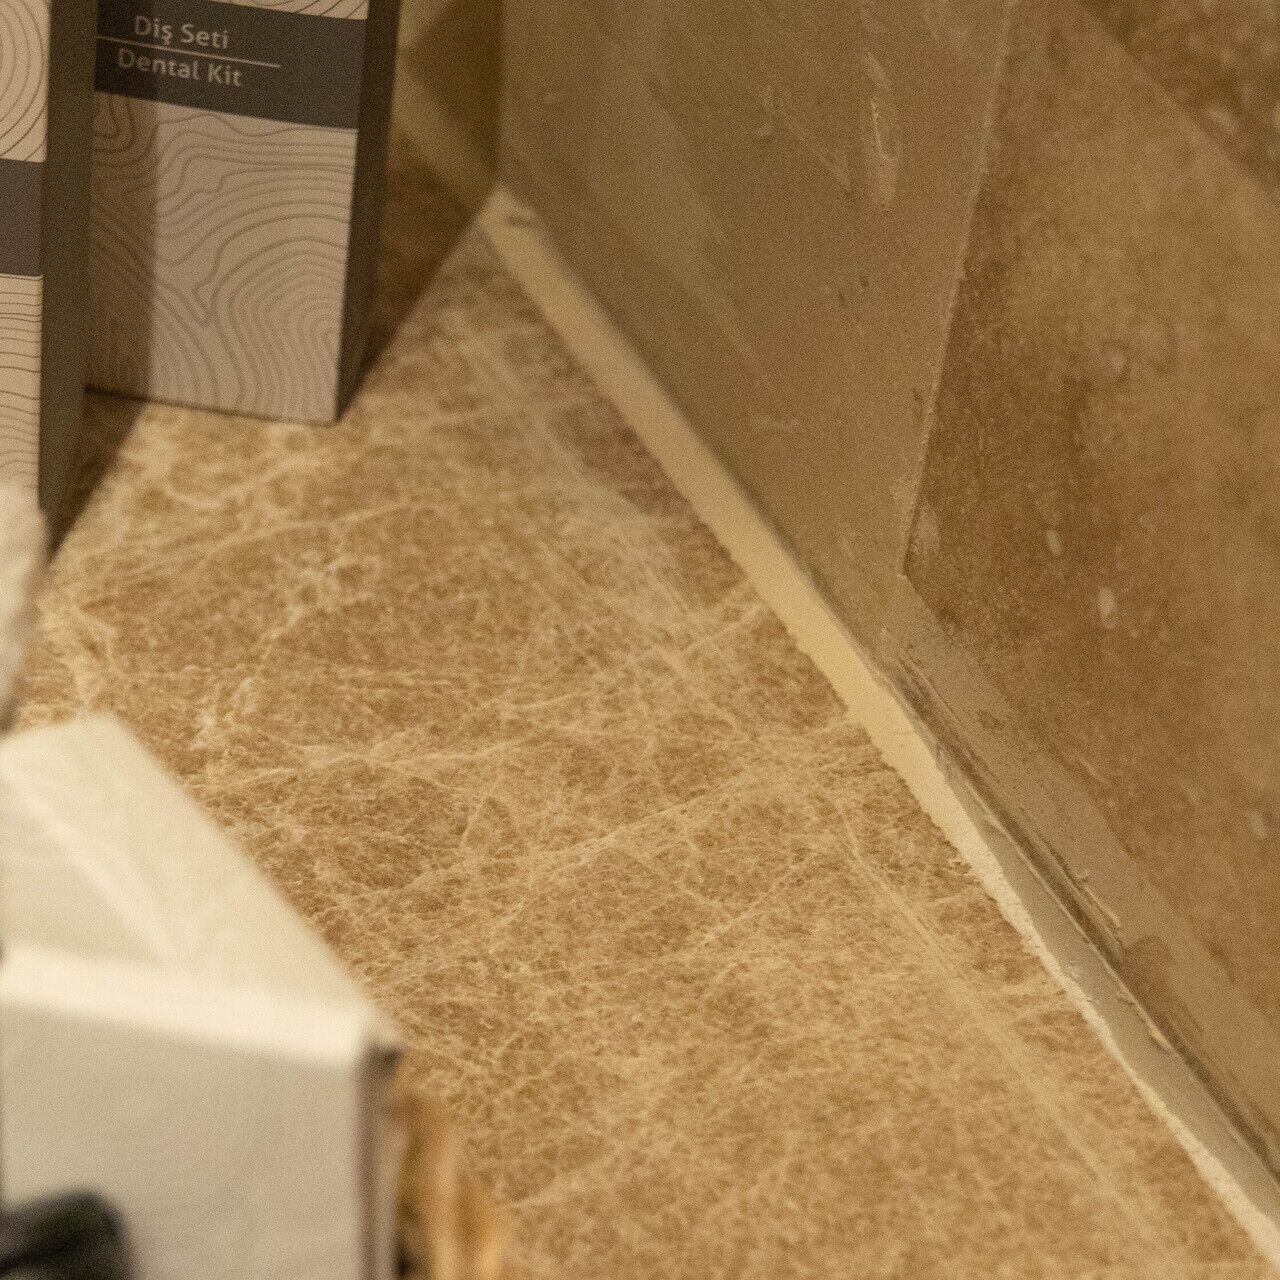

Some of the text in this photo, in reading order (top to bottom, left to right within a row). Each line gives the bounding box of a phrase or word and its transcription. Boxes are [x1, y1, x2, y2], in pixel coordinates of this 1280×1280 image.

[134, 15, 228, 49] Diş Seti
[119, 48, 242, 87] Dental Kit
